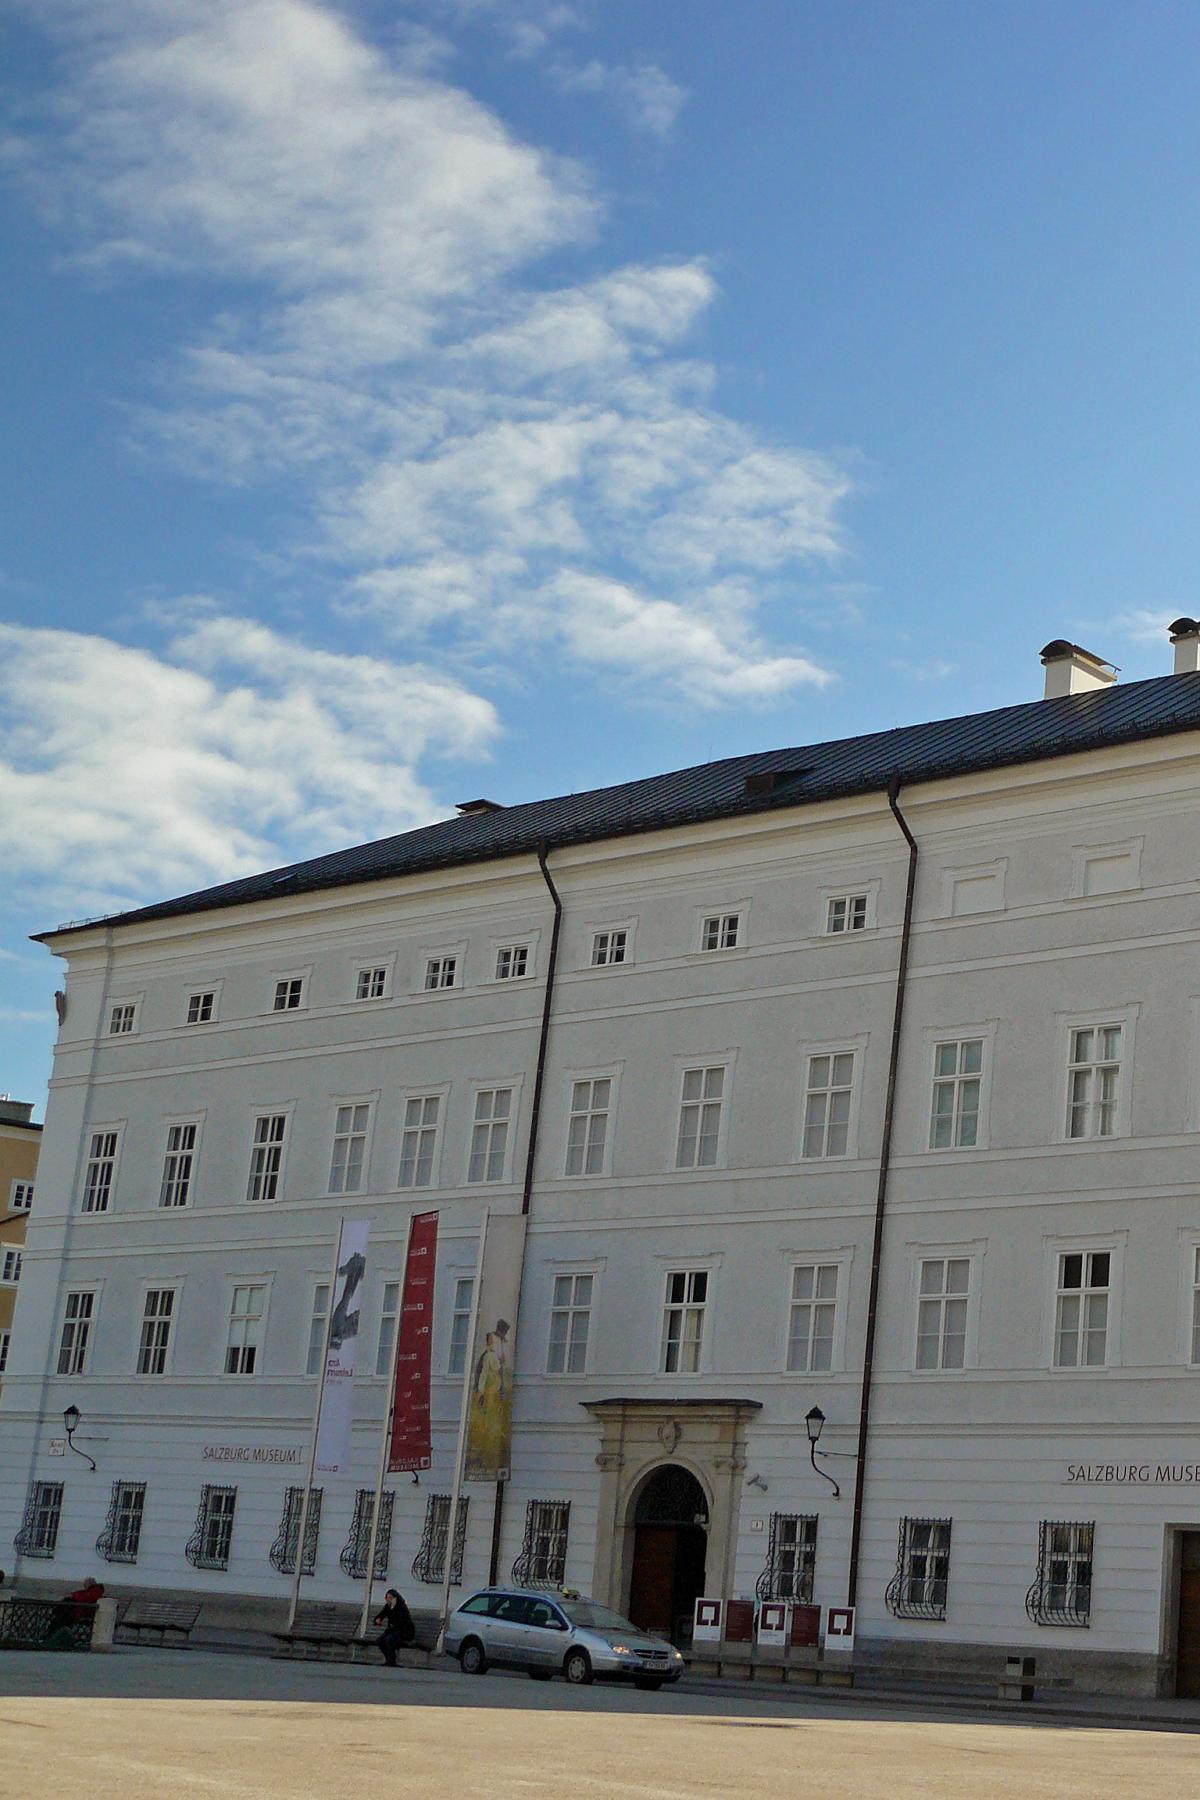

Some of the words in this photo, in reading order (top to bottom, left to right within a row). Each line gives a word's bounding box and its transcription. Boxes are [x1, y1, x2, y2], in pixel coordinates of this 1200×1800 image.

[203, 1446, 250, 1461] SALZBURG
[252, 1448, 296, 1462] MUSEUM
[1067, 1465, 1150, 1482] SALZBURG
